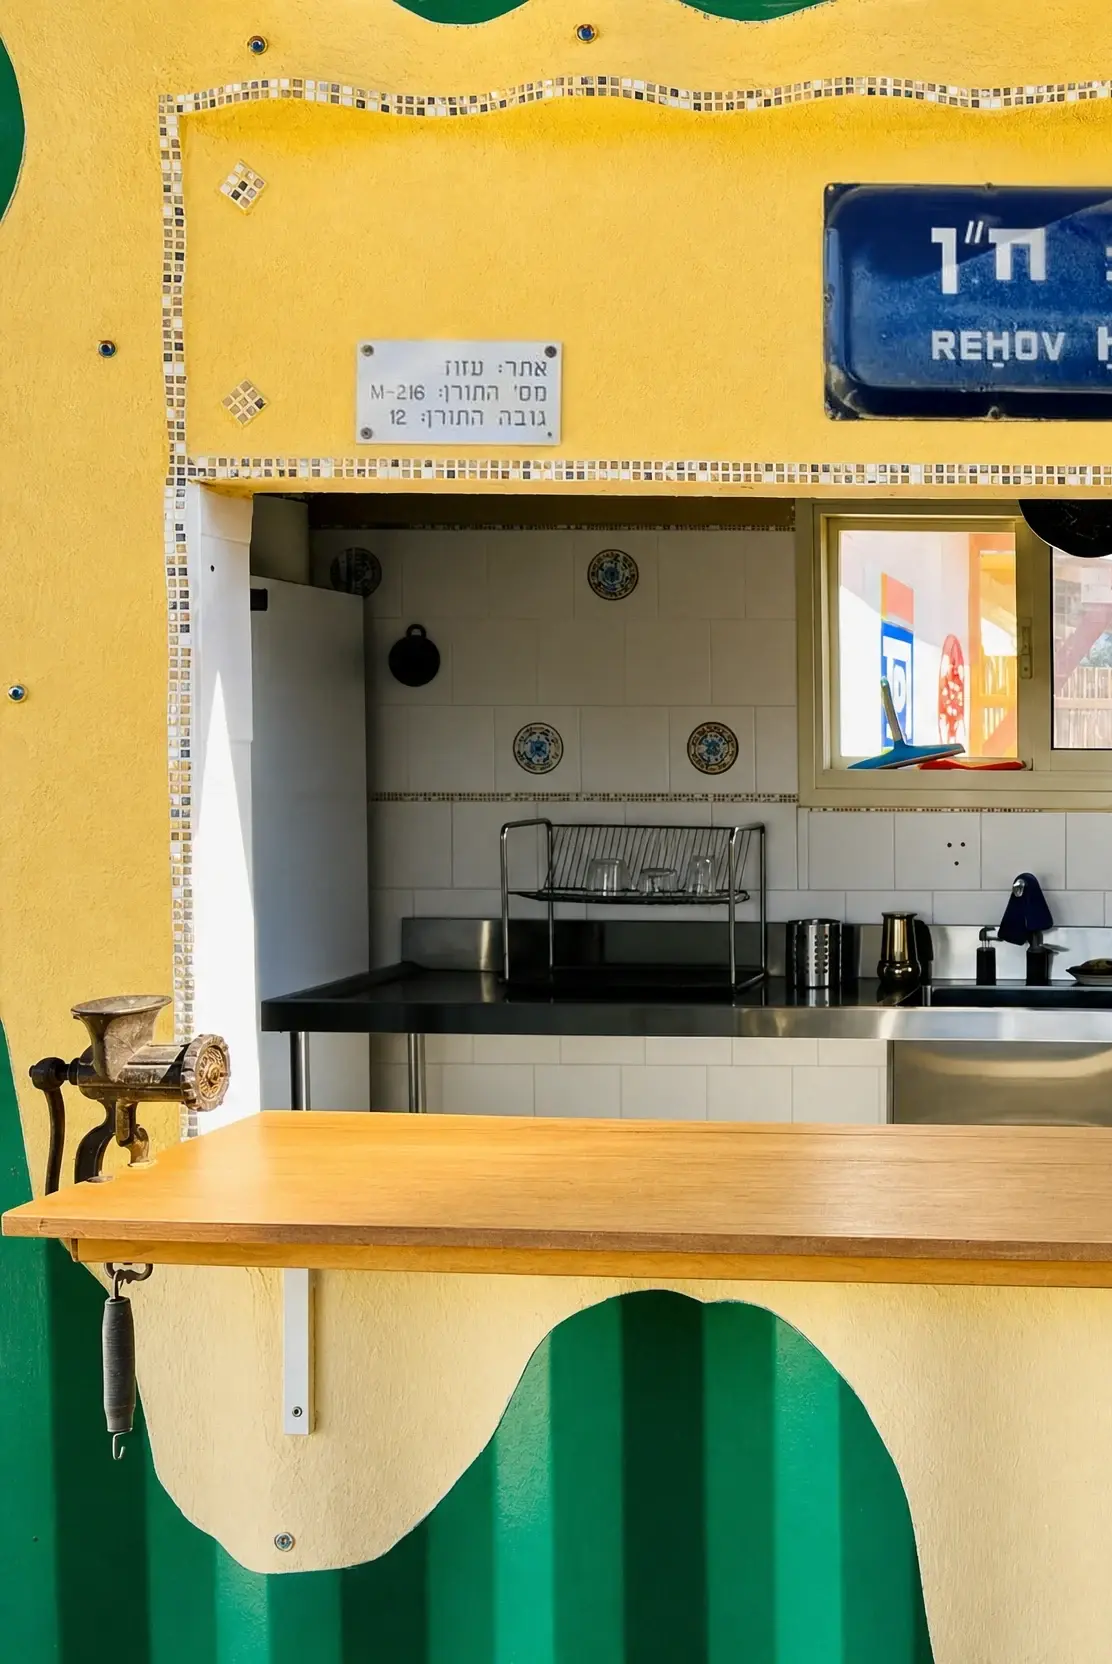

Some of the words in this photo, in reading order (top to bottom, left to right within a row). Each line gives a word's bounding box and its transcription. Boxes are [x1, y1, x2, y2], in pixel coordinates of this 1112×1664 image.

[498, 360, 548, 377] אתר:
[370, 384, 426, 401] M-216
[389, 409, 407, 425] 12
[499, 409, 547, 426] גובה
